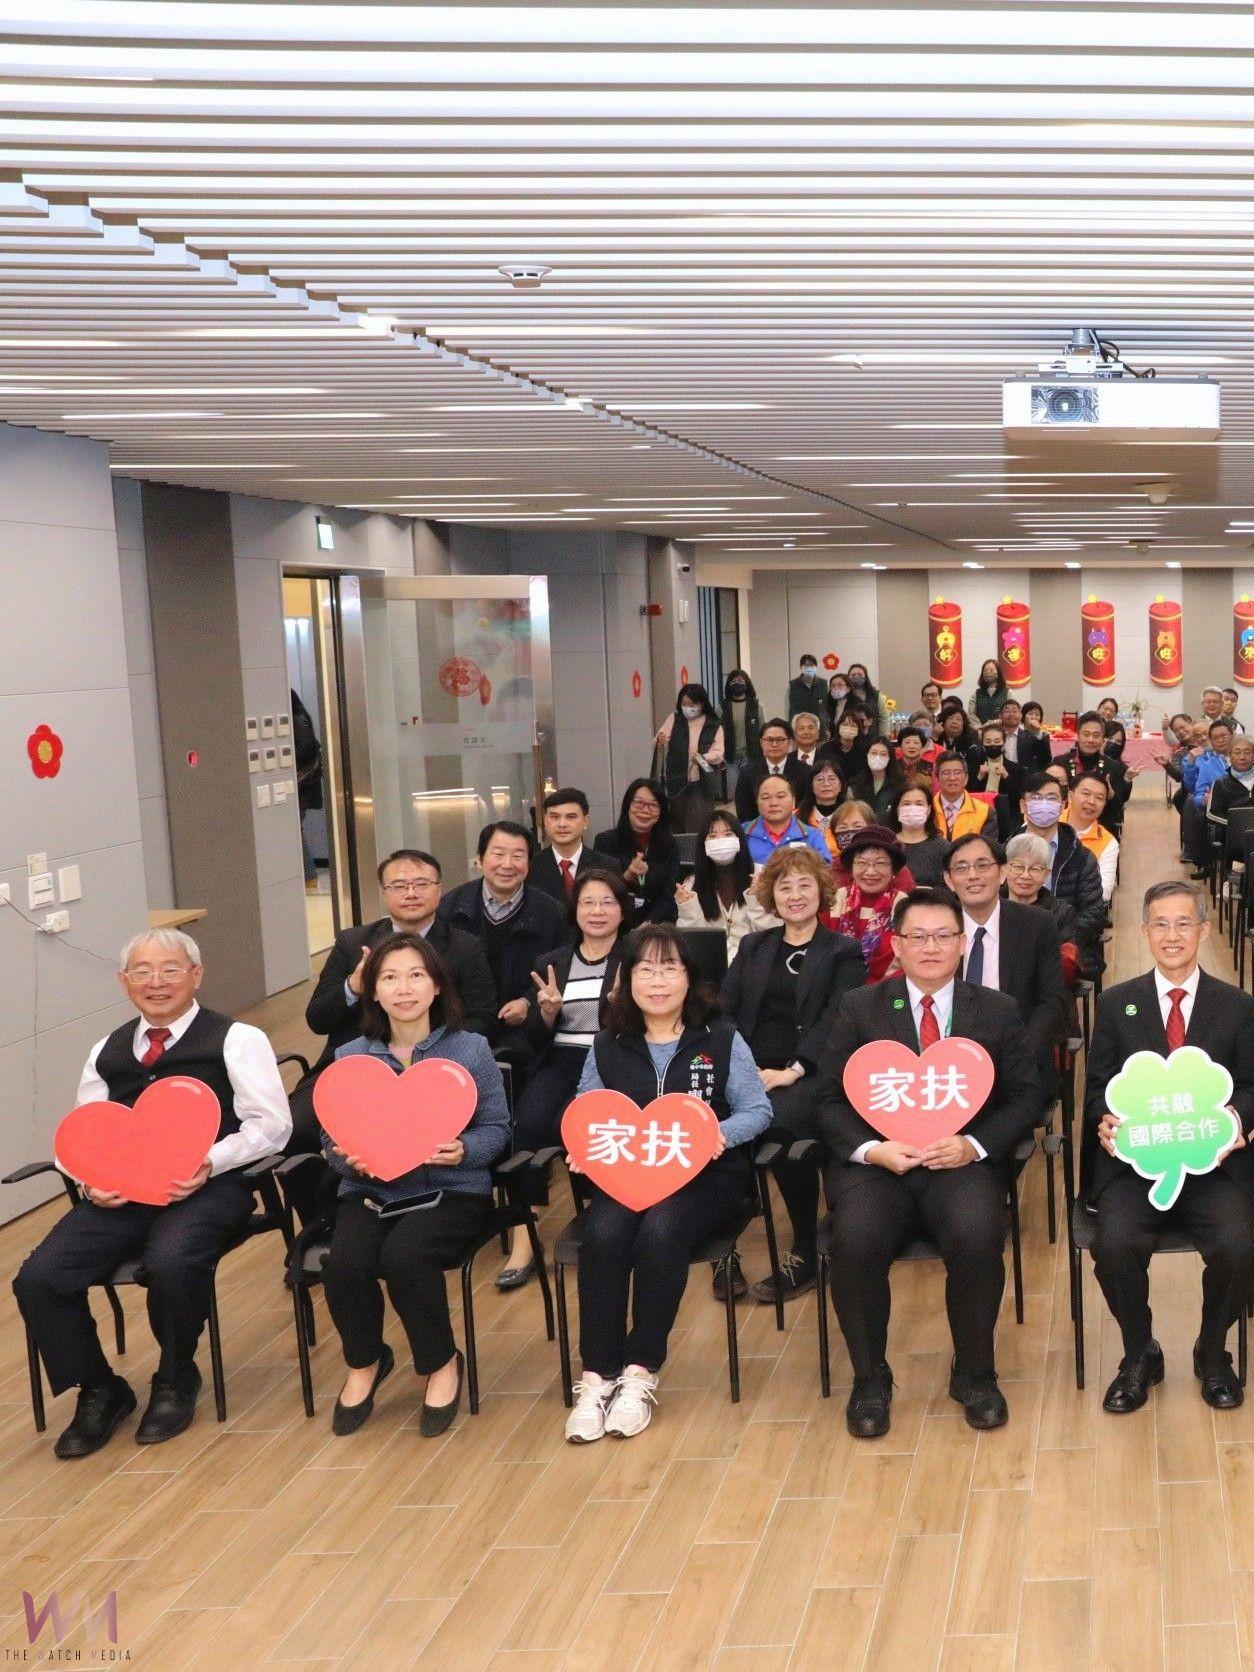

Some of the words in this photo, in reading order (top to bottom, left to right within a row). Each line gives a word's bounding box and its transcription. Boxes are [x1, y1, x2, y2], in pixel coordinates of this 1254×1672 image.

[867, 1064, 971, 1113] 家扶
[1149, 1092, 1194, 1117] 共融
[586, 1118, 693, 1169] 家扶
[1128, 1117, 1220, 1148] 國際合作
